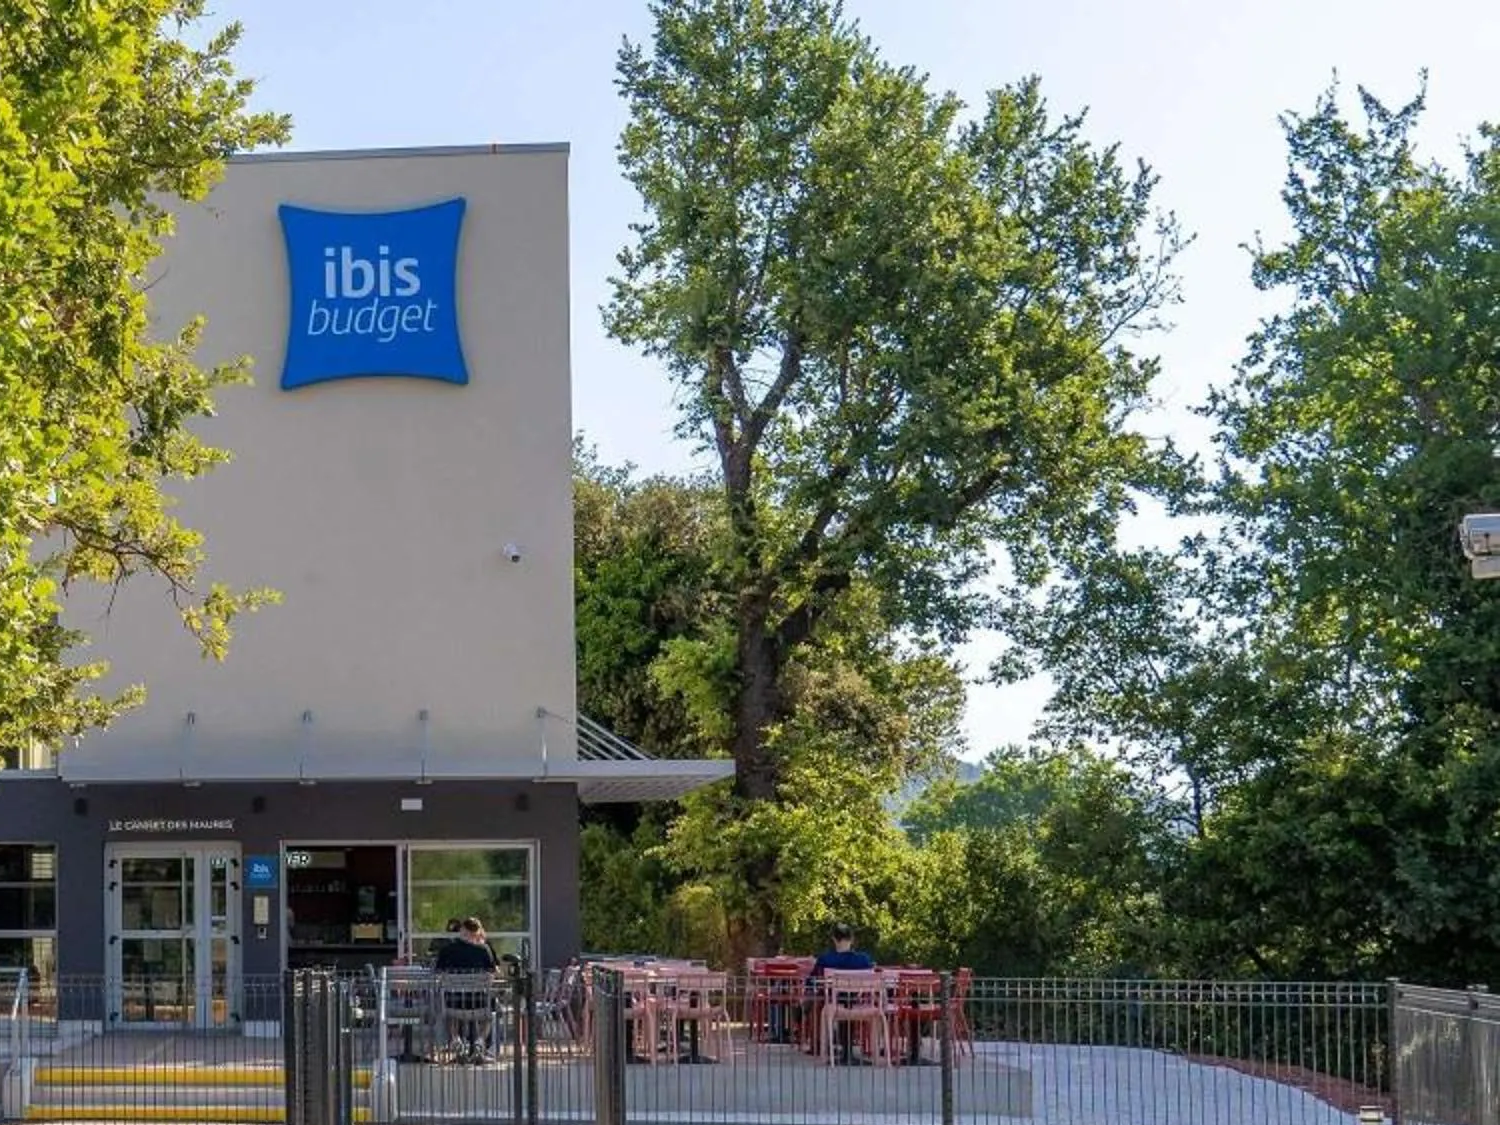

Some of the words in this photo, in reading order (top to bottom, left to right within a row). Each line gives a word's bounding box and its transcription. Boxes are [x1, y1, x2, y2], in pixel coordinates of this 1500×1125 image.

[325, 246, 421, 298] ibis
[308, 298, 437, 342] budget
[109, 820, 122, 831] LE
